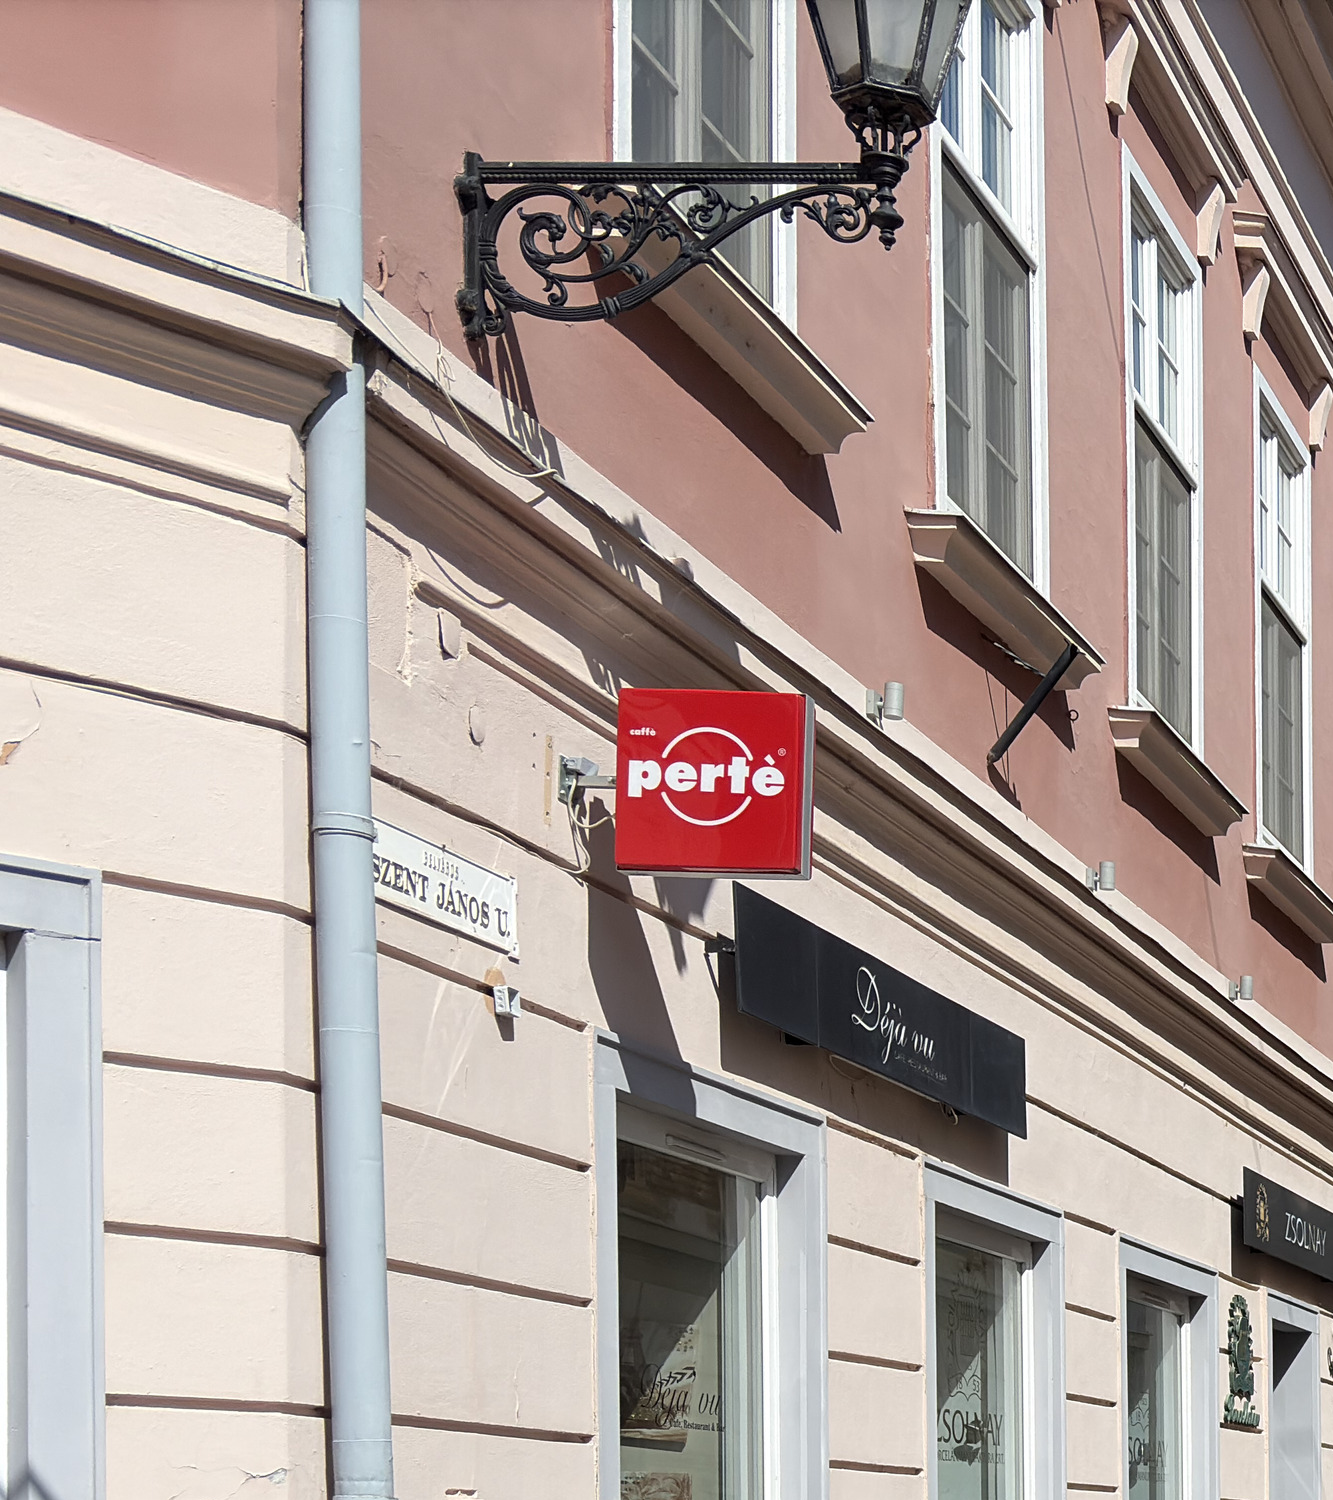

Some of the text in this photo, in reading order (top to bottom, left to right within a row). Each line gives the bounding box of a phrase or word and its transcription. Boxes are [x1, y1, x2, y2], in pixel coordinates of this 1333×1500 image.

[629, 726, 657, 737] caffè
[372, 852, 512, 938] SZENT JÁNOS U.
[911, 1030, 936, 1062] vu
[1284, 1211, 1327, 1257] ZSOLNAY
